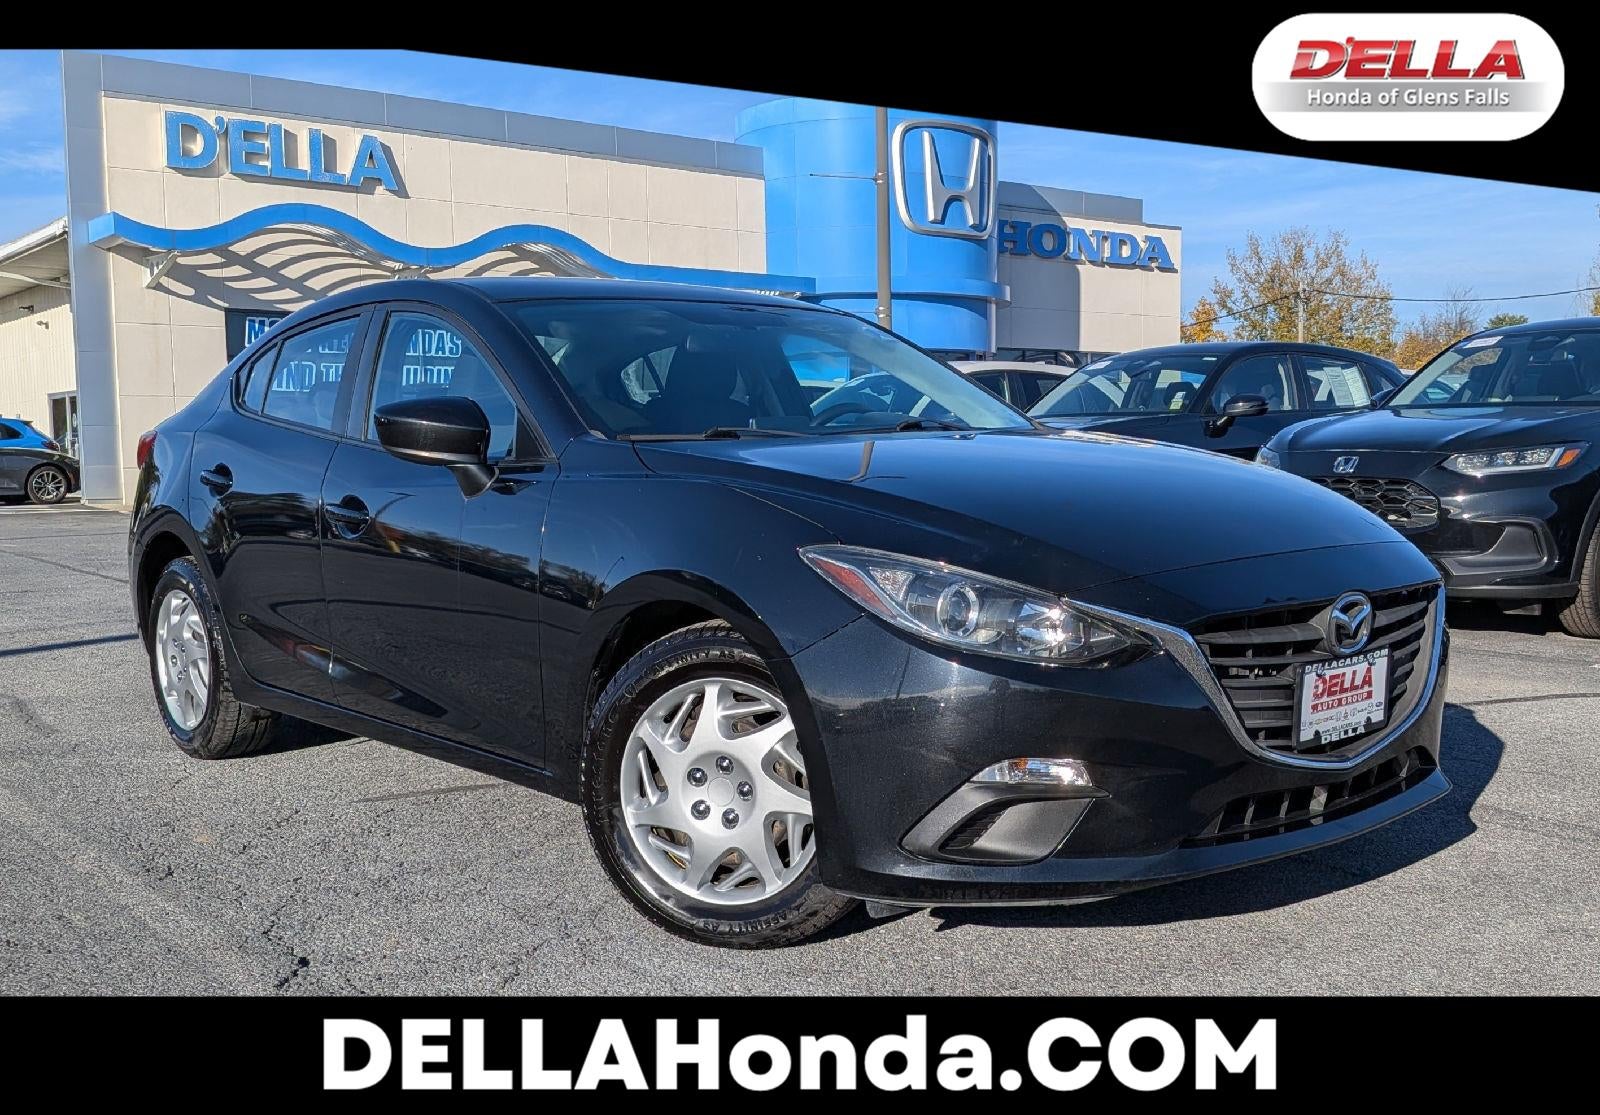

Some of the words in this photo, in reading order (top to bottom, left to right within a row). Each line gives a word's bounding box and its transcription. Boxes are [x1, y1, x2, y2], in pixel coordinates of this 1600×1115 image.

[165, 110, 399, 191] D'ELLA
[999, 219, 1176, 271] HONDA
[1317, 699, 1339, 712] AUTO
[1341, 692, 1368, 706] GROUP
[1321, 725, 1366, 744] DELLA
